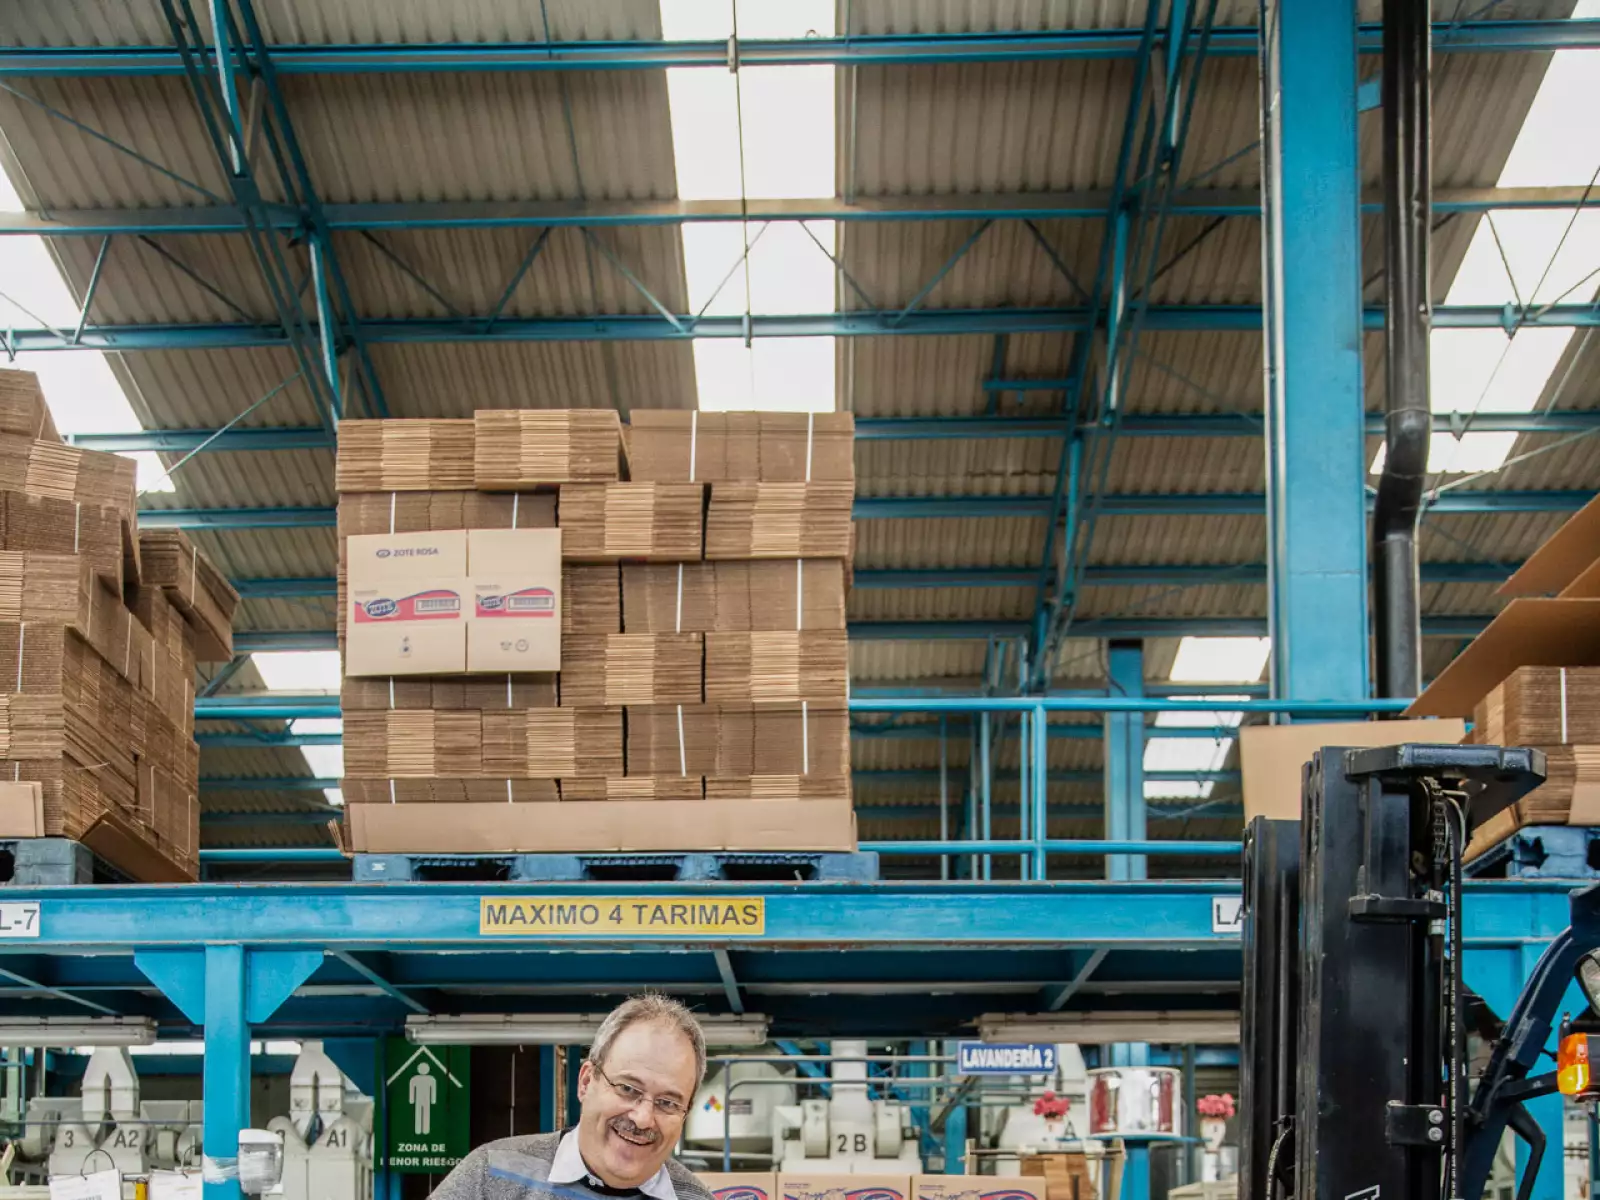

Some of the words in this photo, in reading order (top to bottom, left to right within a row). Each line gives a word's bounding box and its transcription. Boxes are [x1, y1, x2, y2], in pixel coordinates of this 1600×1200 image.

[486, 904, 599, 925] MAXIMO
[608, 904, 623, 925] 4
[632, 904, 759, 925] TARIMAS
[963, 1045, 1042, 1068] LAVANDERÍA
[1044, 1049, 1053, 1068] 2
[64, 1130, 74, 1148] 3
[114, 1130, 138, 1148] A2
[326, 1129, 347, 1147] A1
[398, 1144, 428, 1152] ZONA
[431, 1144, 446, 1152] DE
